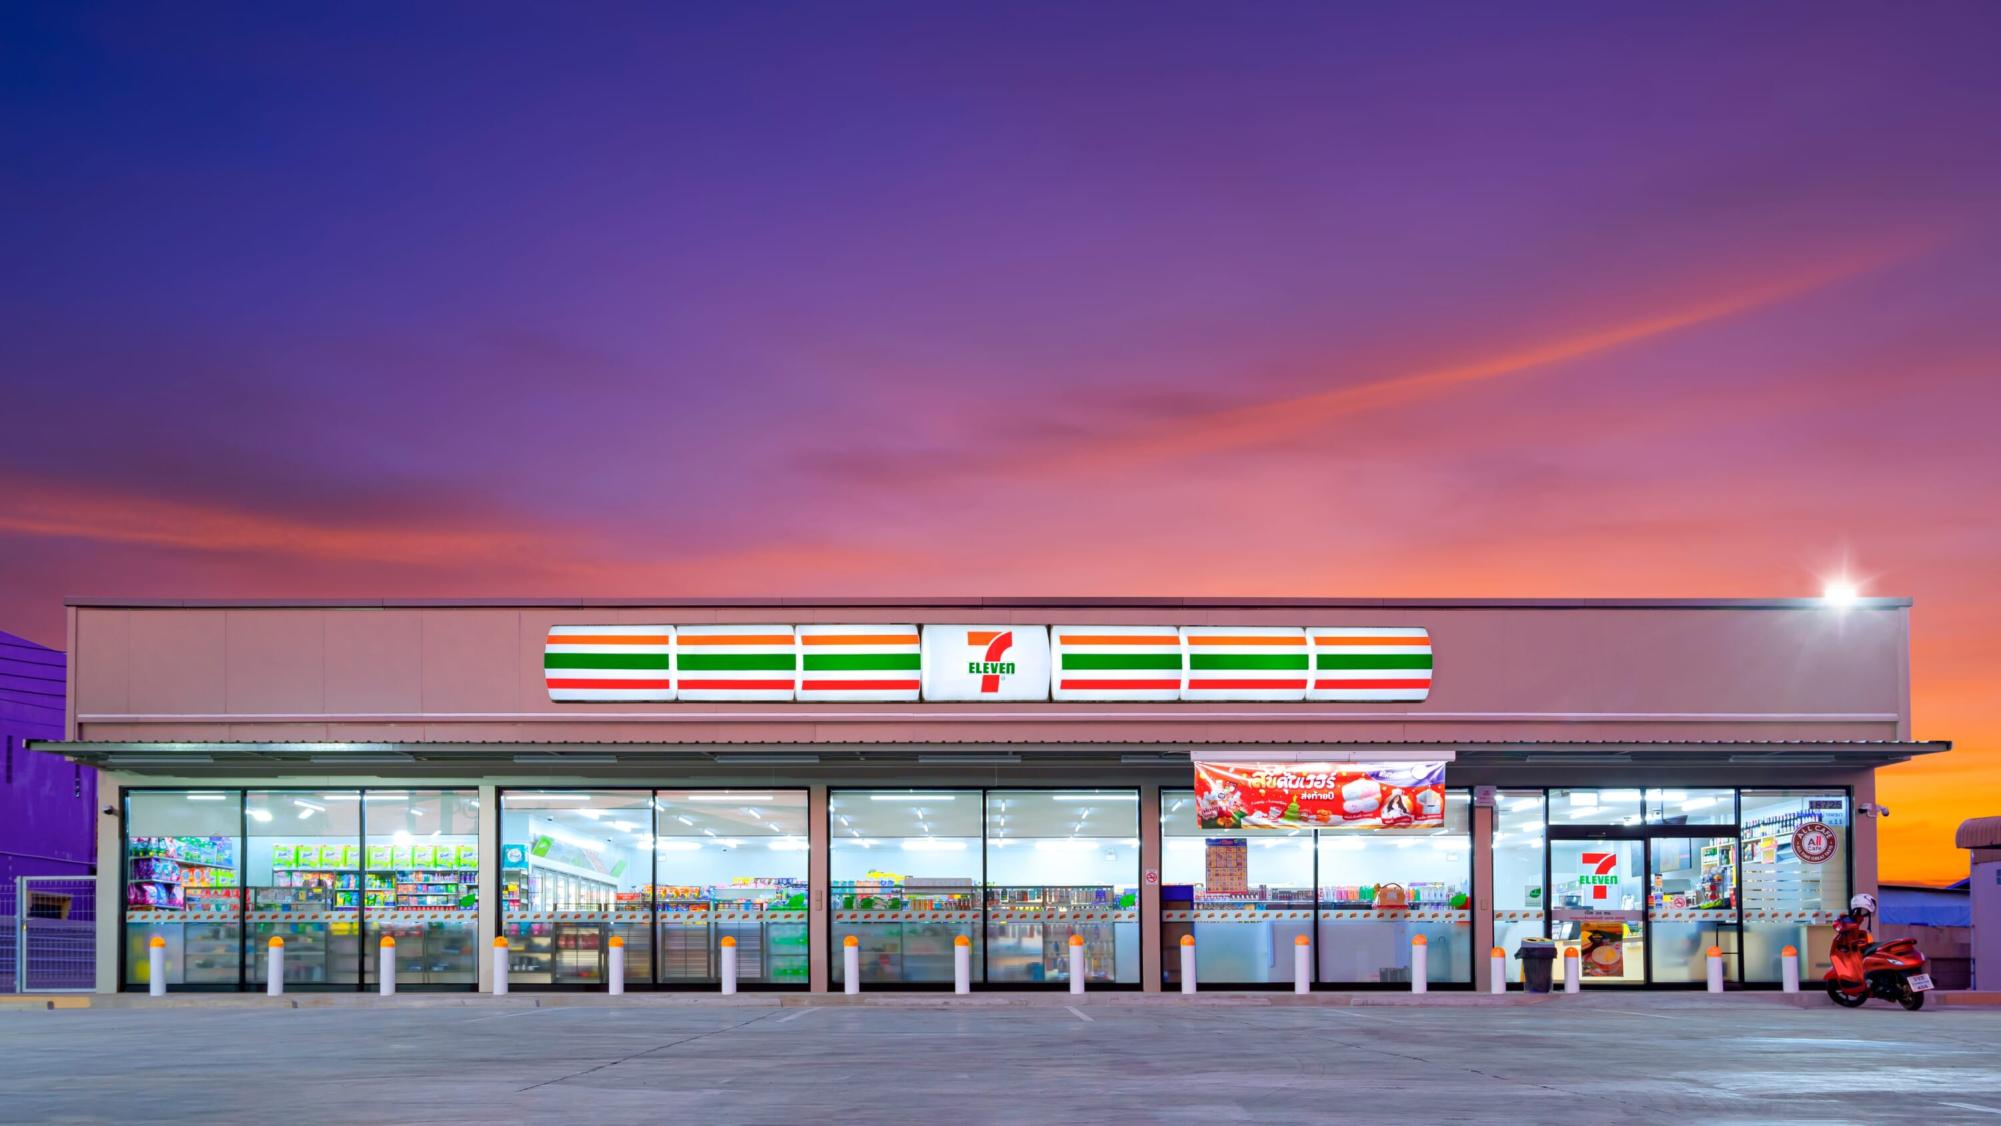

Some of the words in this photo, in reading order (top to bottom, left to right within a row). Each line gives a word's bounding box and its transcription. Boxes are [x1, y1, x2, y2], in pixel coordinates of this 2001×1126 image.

[967, 631, 1012, 692] 7
[1797, 826, 1813, 839] ALL
[1808, 833, 1822, 846] All
[1582, 853, 1617, 899] 7
